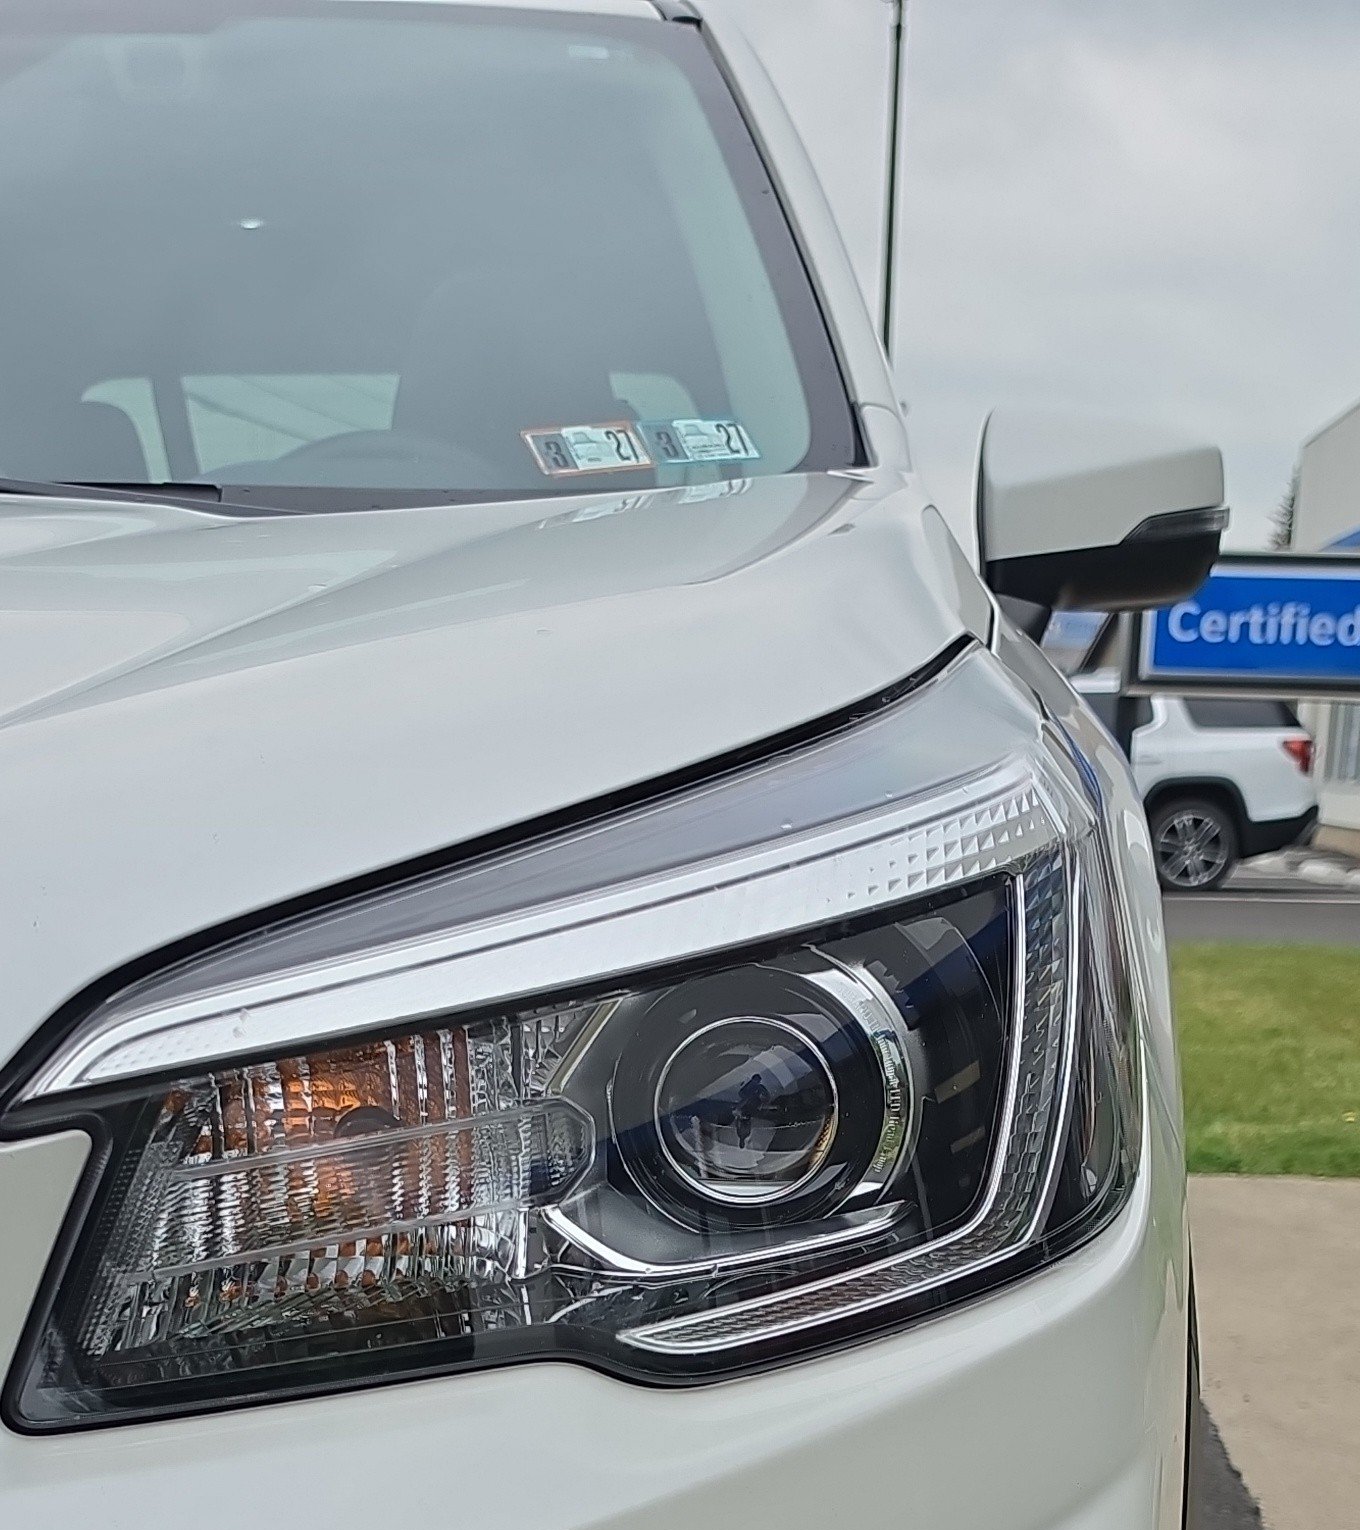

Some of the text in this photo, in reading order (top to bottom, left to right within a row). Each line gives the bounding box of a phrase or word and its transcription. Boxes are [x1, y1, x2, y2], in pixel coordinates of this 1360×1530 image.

[545, 429, 640, 467] 3 27
[655, 431, 679, 458] 3
[715, 423, 750, 456] 27
